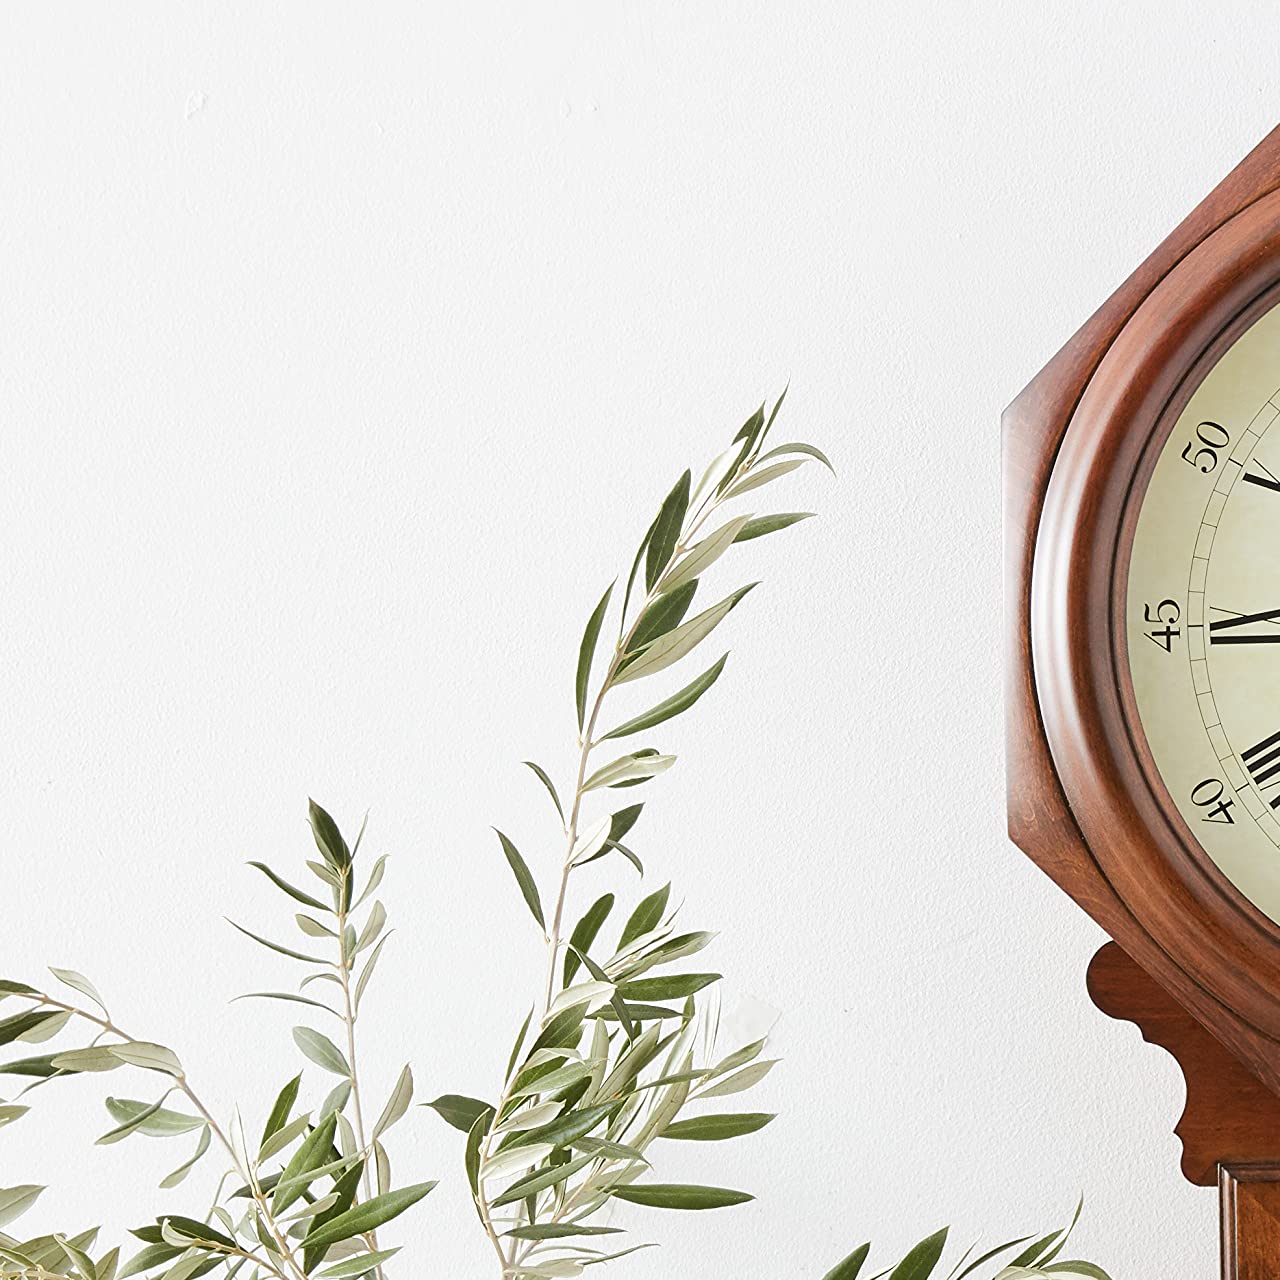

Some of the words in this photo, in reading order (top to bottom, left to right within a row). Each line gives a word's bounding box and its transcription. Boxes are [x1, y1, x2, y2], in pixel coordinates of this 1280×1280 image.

[1181, 421, 1231, 473] 50
[1144, 598, 1181, 653] 45
[1190, 777, 1238, 826] 40
